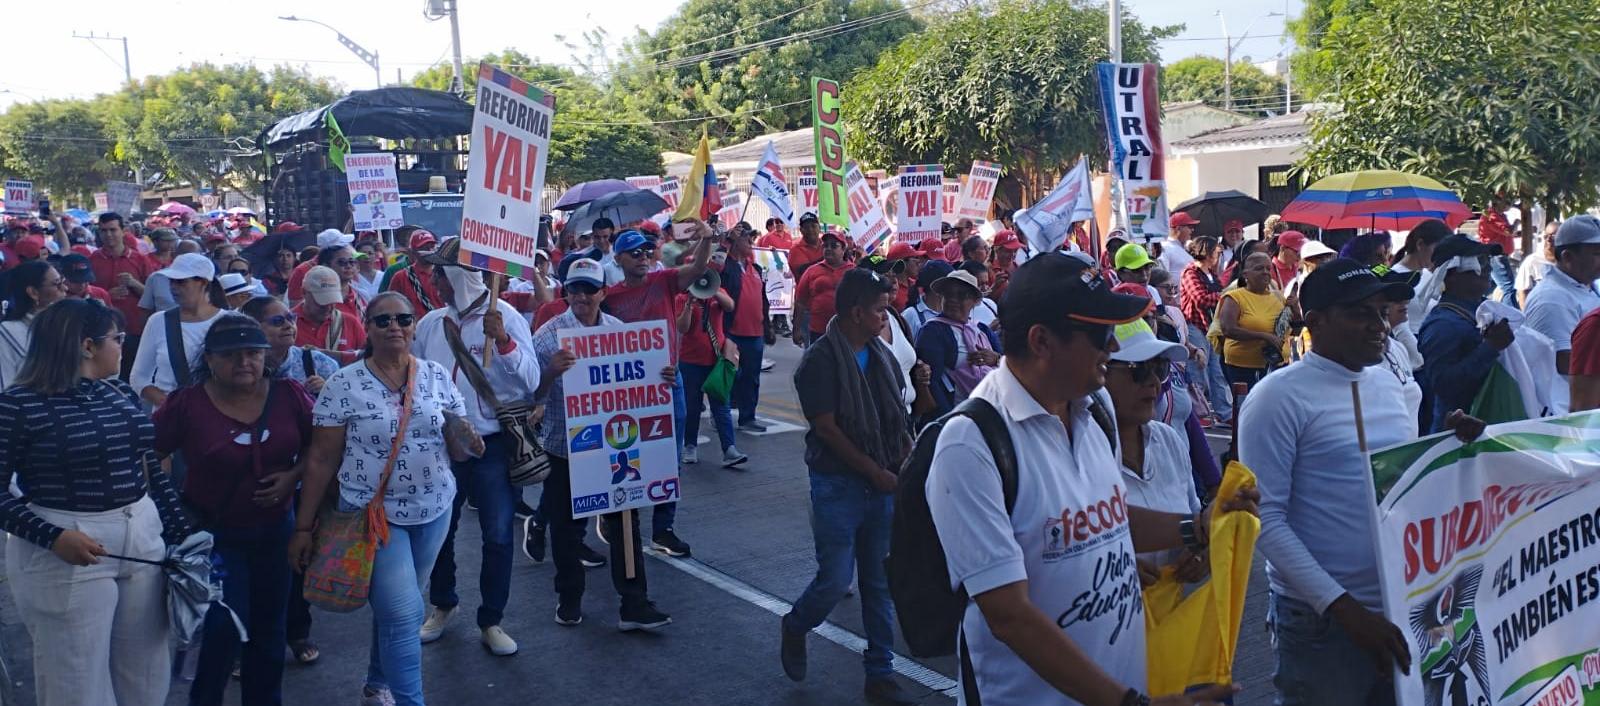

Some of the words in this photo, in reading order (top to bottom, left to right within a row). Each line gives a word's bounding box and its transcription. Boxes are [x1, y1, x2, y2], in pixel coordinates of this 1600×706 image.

[480, 86, 549, 139] REFORMA
[1118, 67, 1150, 180] UTRAL
[817, 79, 843, 216] CGT
[346, 156, 392, 166] ENEMIGOS
[370, 169, 384, 177] LAS
[484, 125, 538, 203] YA!
[972, 167, 998, 179] REFORMA
[350, 180, 396, 190] REFORMAS
[901, 174, 941, 187] REFORMA
[971, 179, 992, 200] YA!
[9, 189, 28, 201] YA!
[905, 190, 936, 217] YA!
[462, 217, 534, 259] CONSTITUYENTE
[898, 230, 940, 242] CONSTITUYENTE
[561, 328, 665, 359] ENEMIGOS
[590, 365, 611, 385] DE
[615, 360, 645, 382] LAS
[567, 383, 671, 418] REFORMAS
[575, 495, 607, 508] MIRA
[1493, 570, 1572, 664] TAMBIÉN
[1576, 563, 1600, 607] ES
